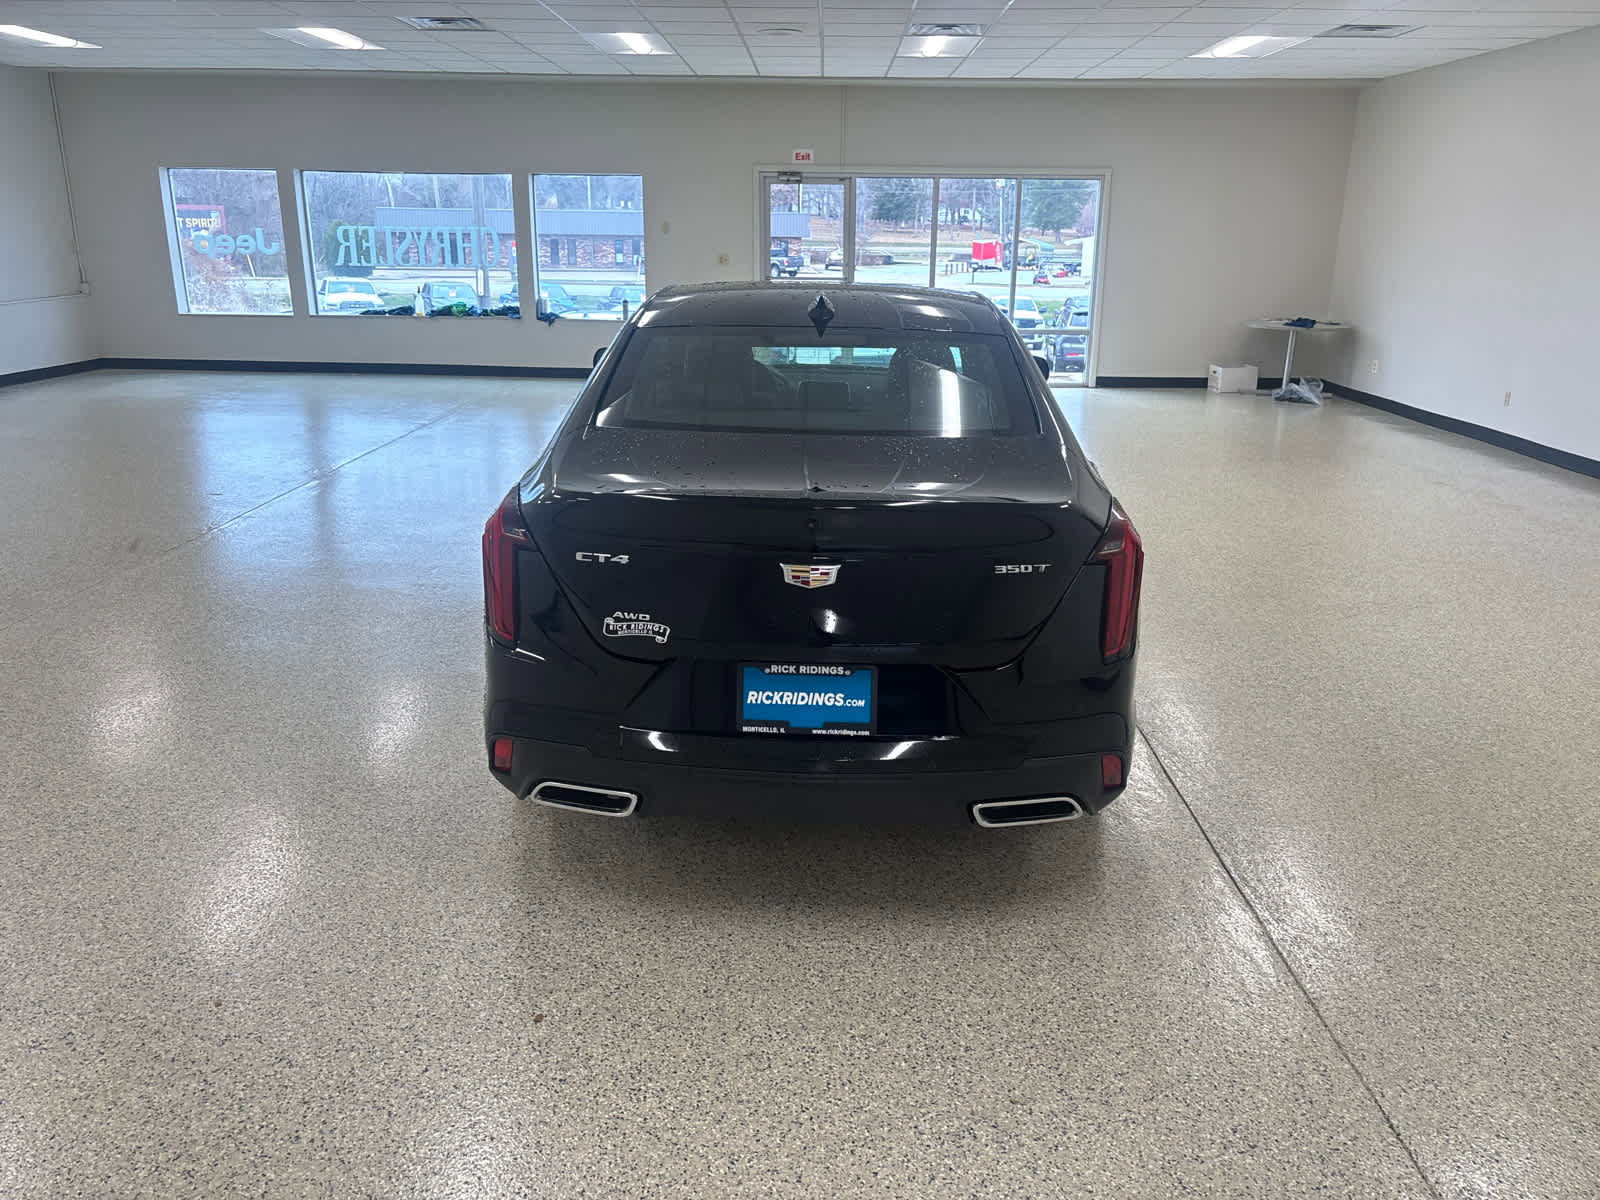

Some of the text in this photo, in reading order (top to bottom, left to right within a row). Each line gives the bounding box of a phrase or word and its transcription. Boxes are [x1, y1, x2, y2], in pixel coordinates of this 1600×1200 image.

[795, 152, 811, 160] Exit
[576, 551, 630, 565] CT4
[994, 564, 1053, 574] 350T
[612, 611, 651, 621] AWD
[631, 623, 665, 633] RIDINGS
[770, 664, 845, 675] RICK RIDINGS
[812, 729, 871, 737] www.rickridings.com
